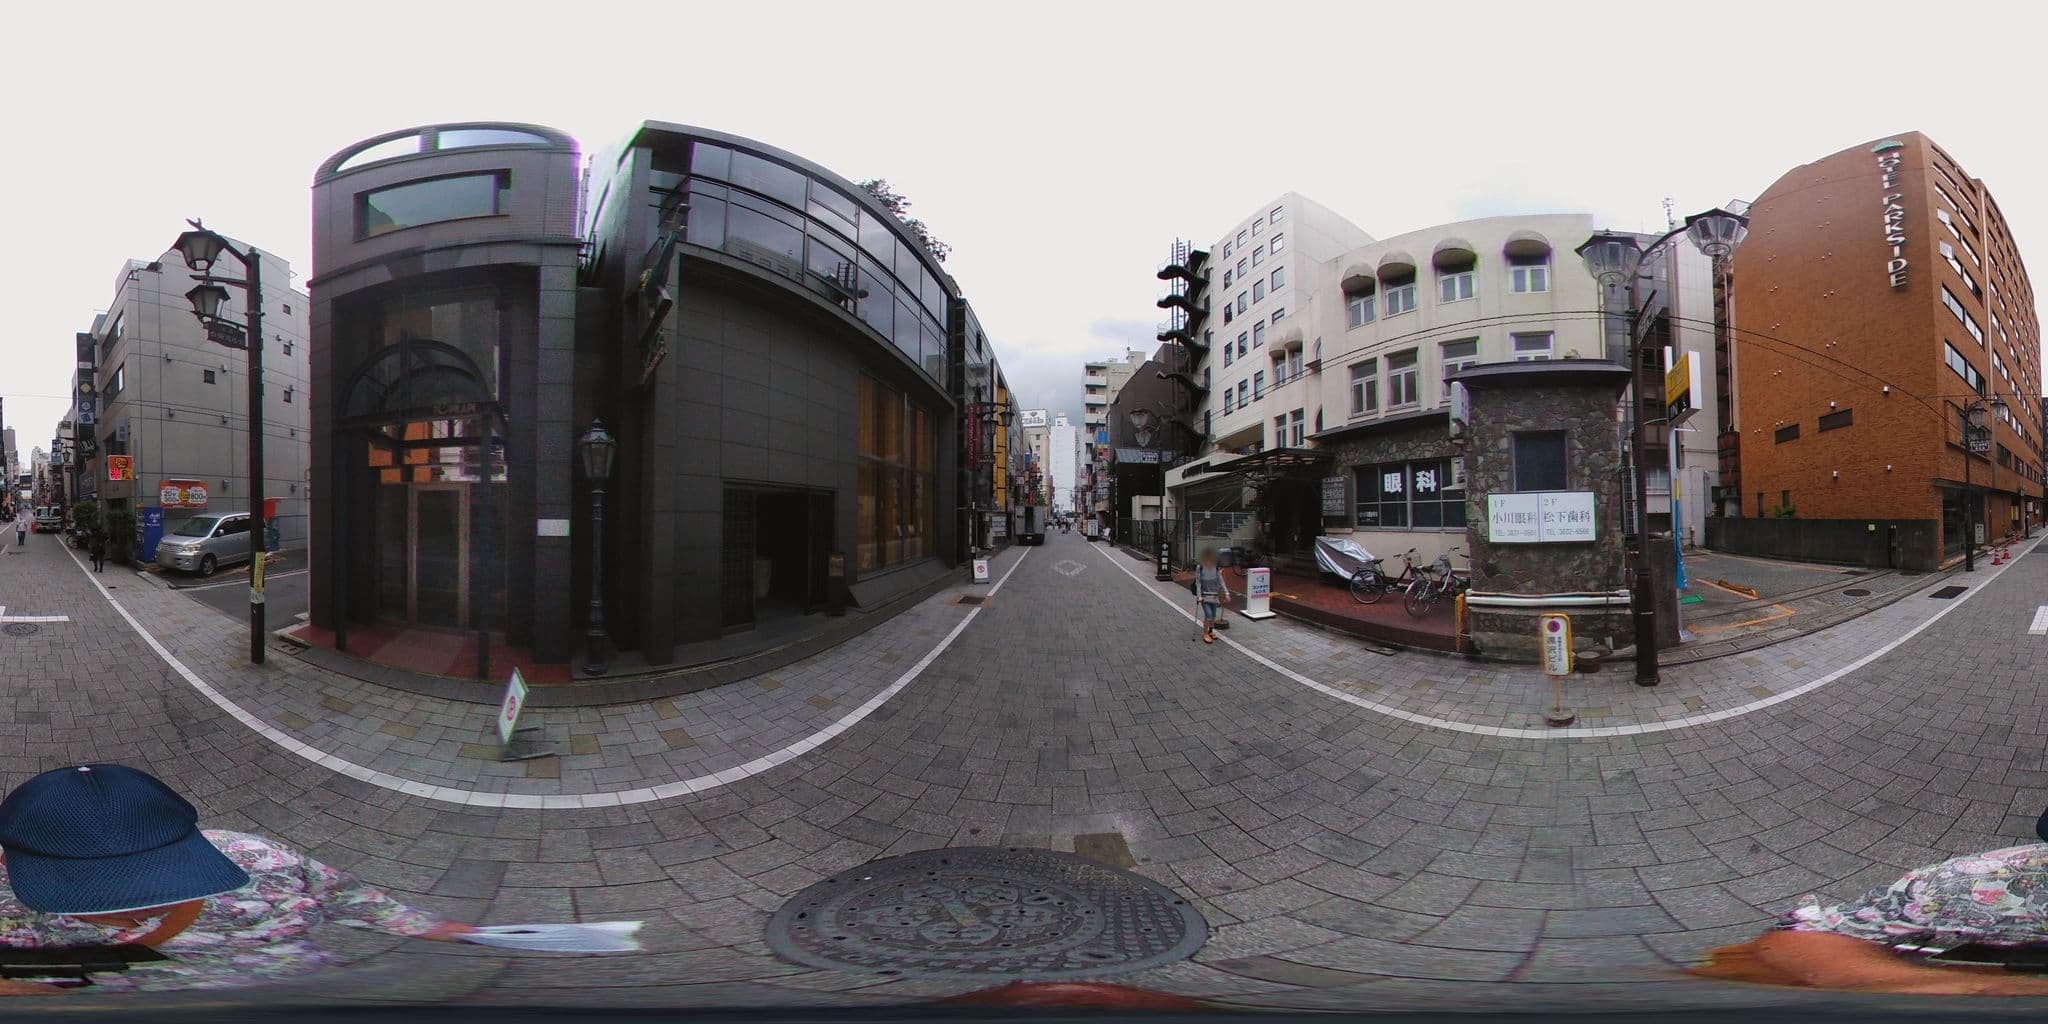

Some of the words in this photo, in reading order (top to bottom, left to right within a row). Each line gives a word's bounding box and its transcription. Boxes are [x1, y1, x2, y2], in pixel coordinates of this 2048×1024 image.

[1878, 152, 1900, 189] HOTEL
[1883, 193, 1908, 288] PARKSIDE
[1492, 511, 1537, 524] 小川眼科
[1543, 510, 1591, 523] 松下歯科
